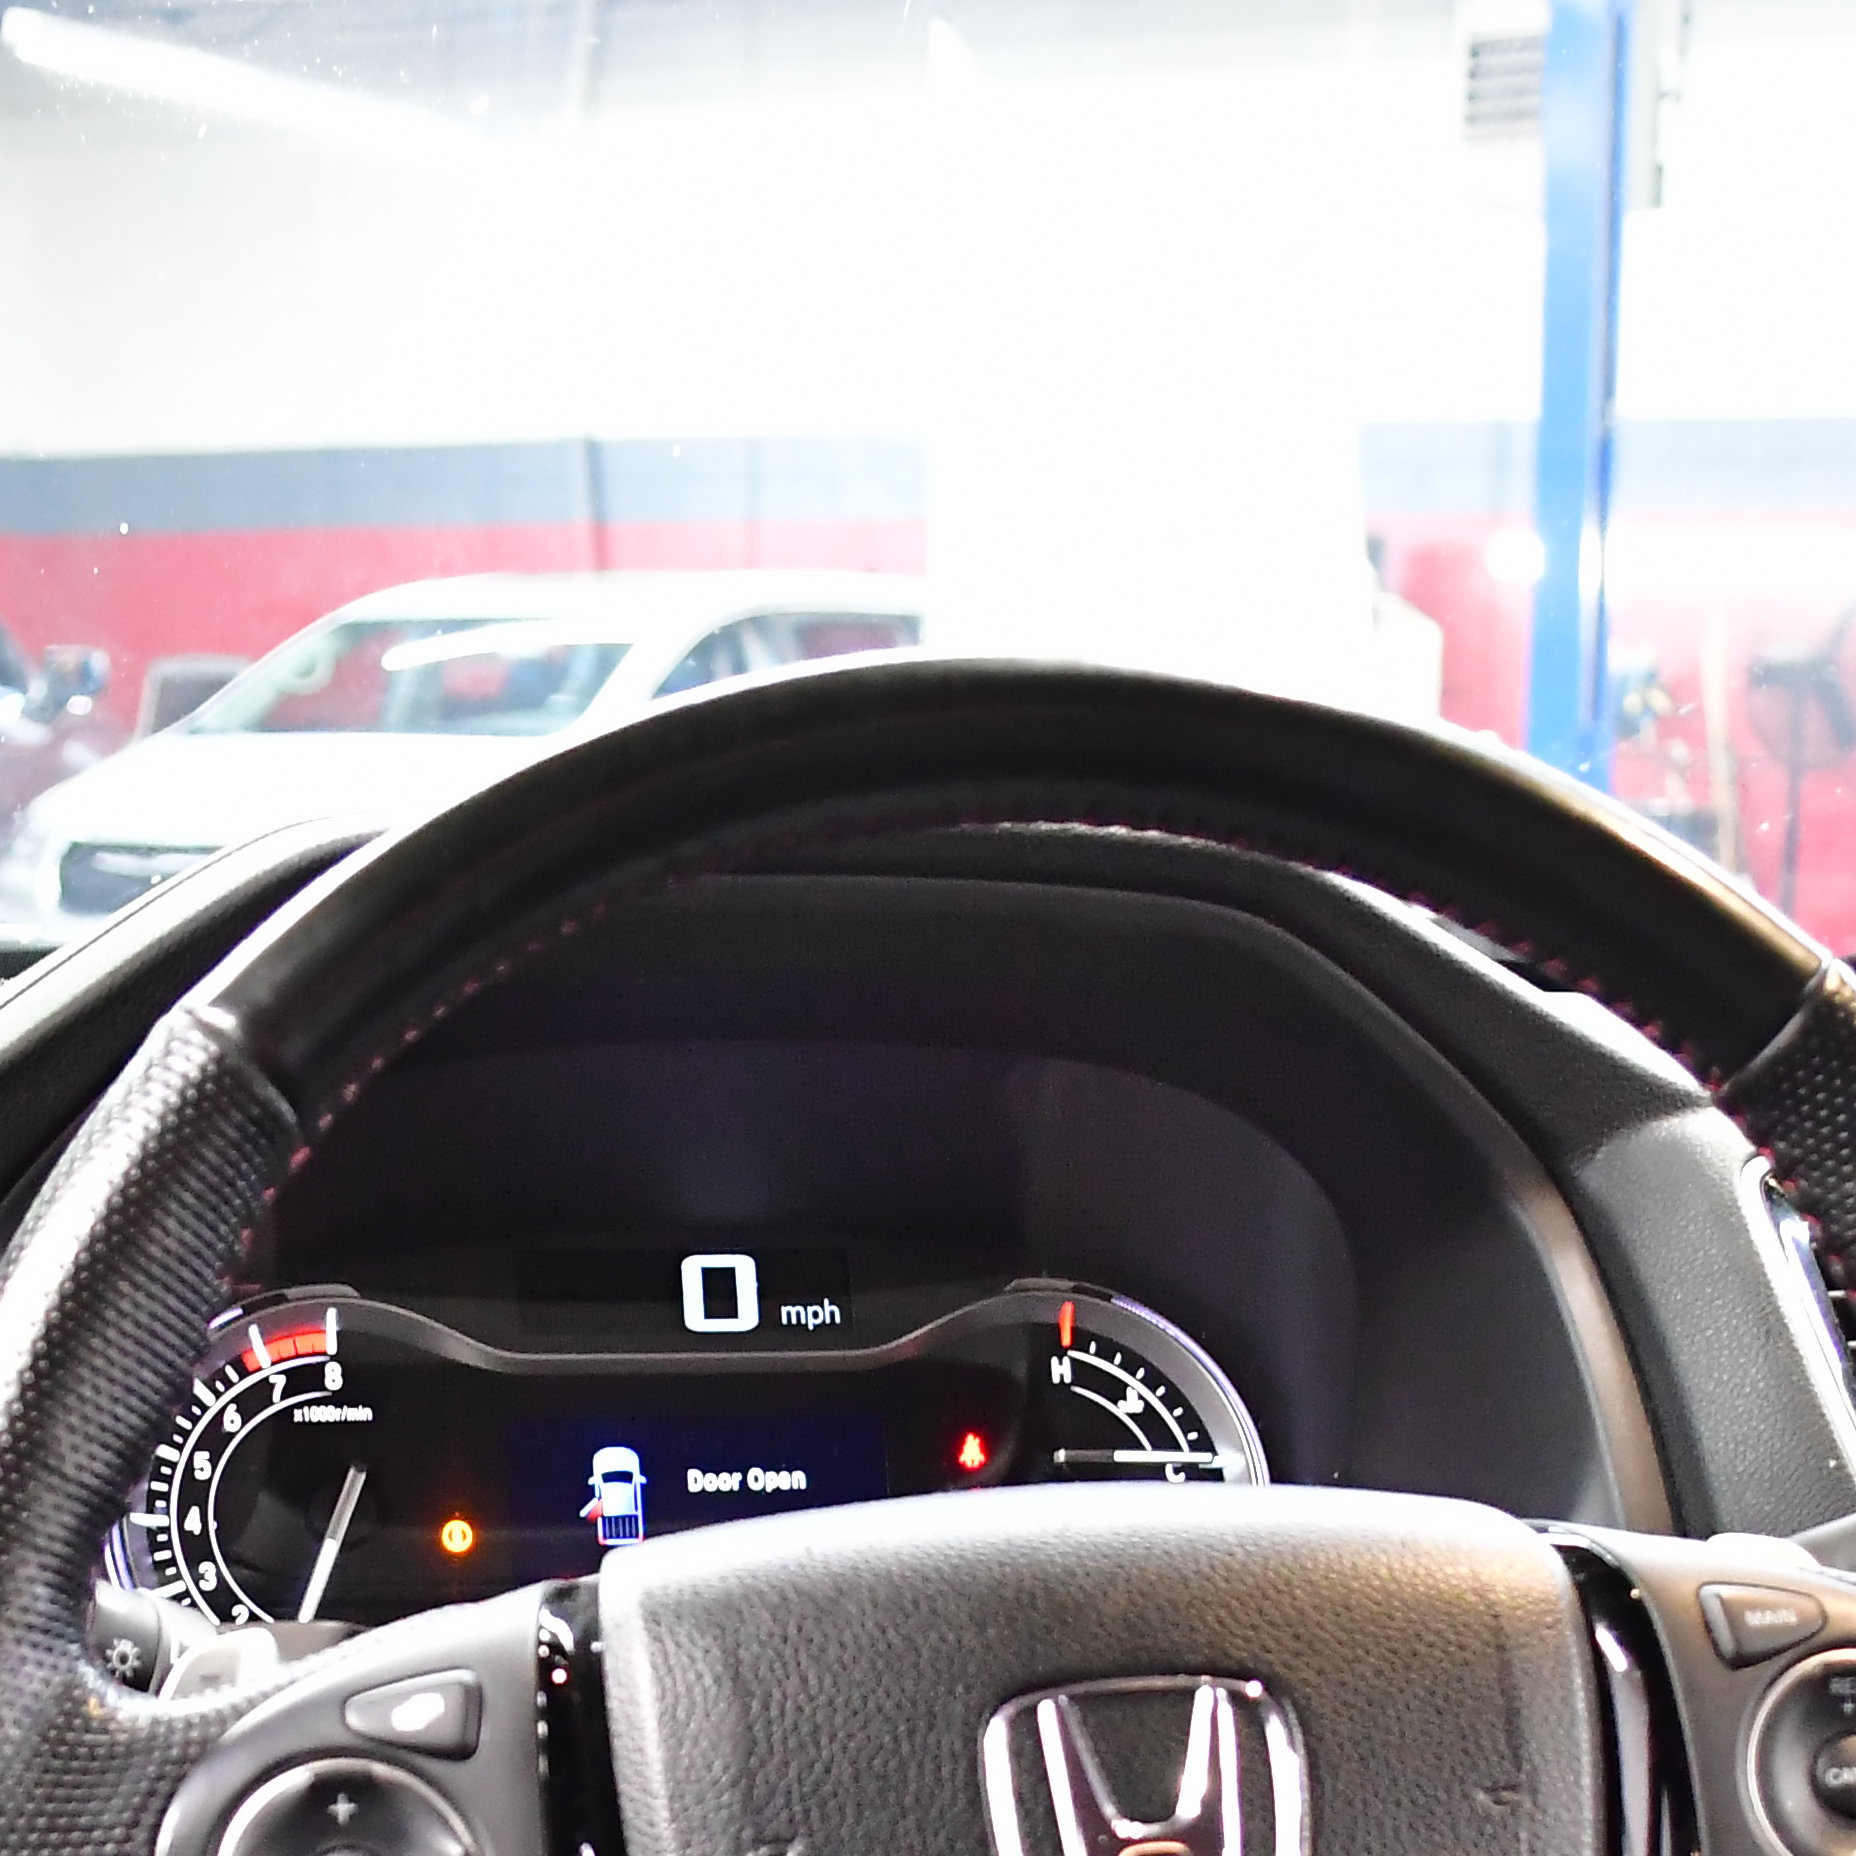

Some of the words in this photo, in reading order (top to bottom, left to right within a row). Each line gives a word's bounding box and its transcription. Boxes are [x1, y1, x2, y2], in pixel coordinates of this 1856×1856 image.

[681, 1254, 759, 1333] 0
[780, 1298, 841, 1330] mph
[323, 1361, 343, 1391] 8
[1050, 1355, 1072, 1384] H
[268, 1374, 287, 1403] 7
[223, 1404, 242, 1433] 6
[192, 1450, 212, 1480] 5
[687, 1467, 742, 1493] Door
[747, 1466, 807, 1493] Open
[184, 1505, 202, 1536] 4
[198, 1561, 217, 1591] 3
